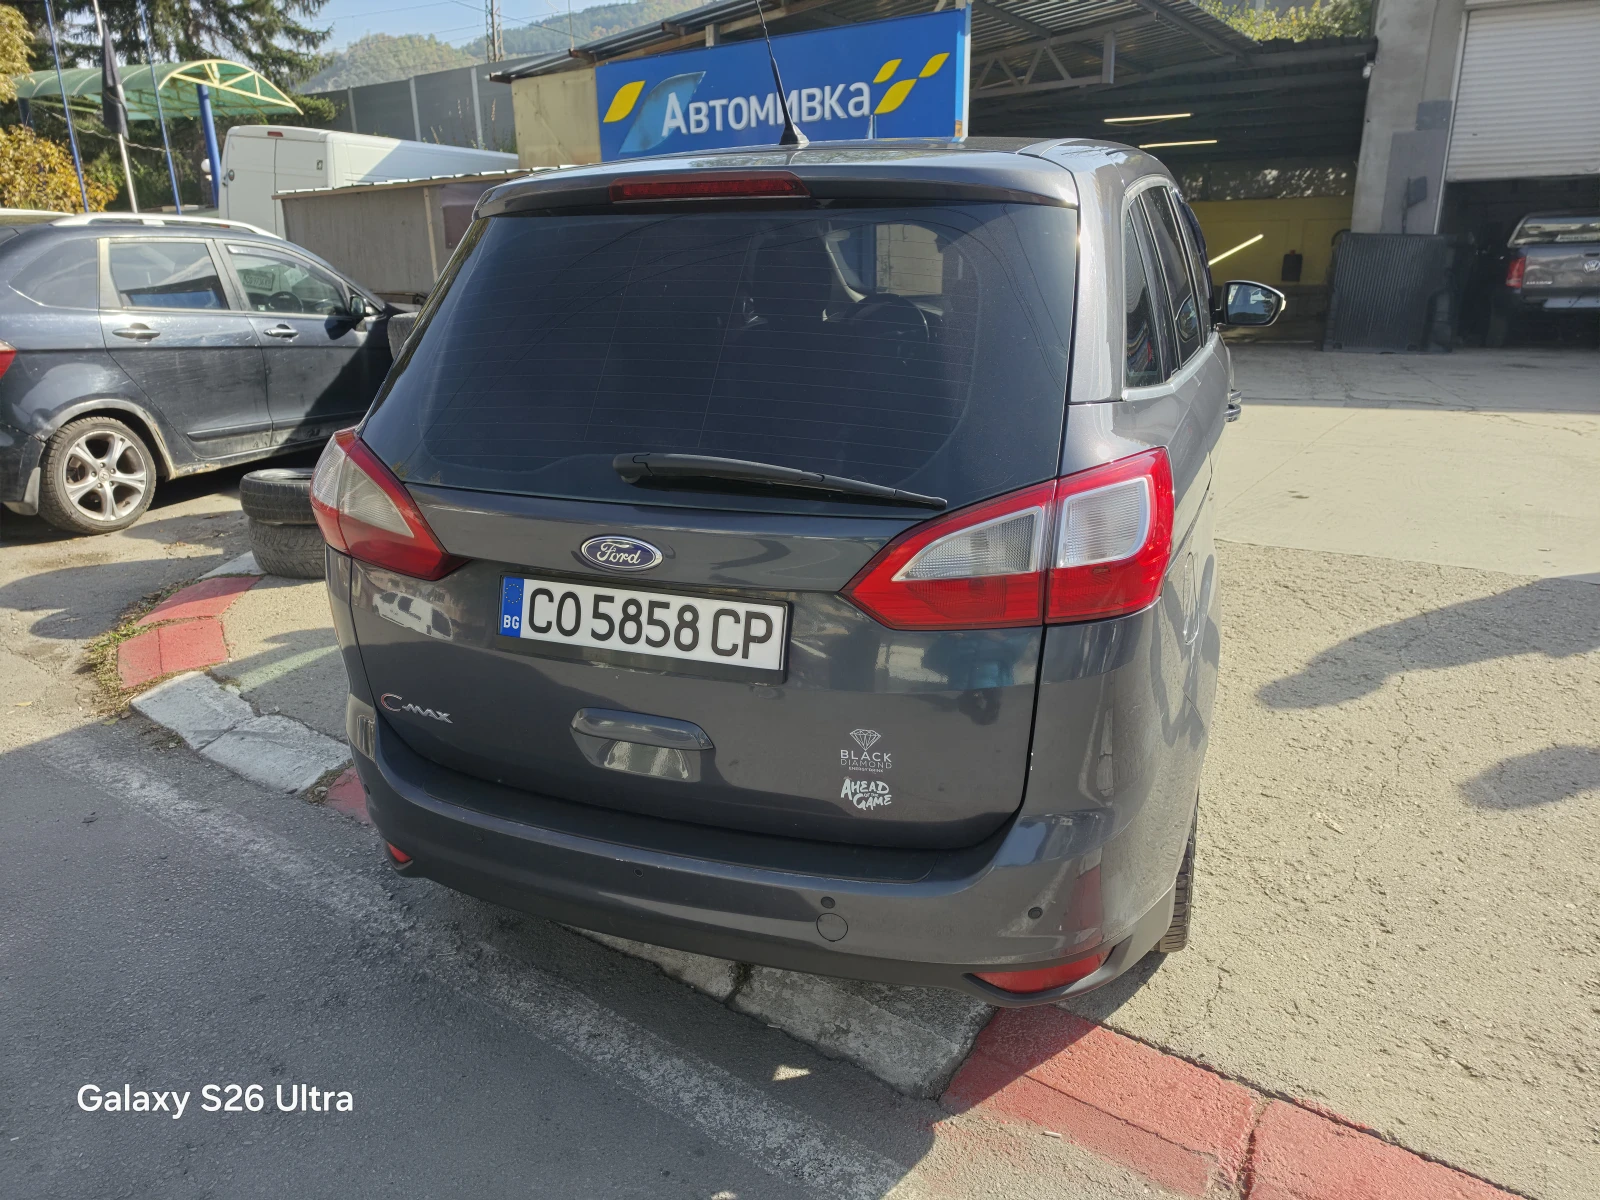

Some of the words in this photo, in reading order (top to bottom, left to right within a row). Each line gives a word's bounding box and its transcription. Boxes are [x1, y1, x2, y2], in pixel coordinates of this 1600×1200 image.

[596, 541, 642, 564] Ford
[503, 614, 520, 629] BG
[528, 587, 582, 637] CO
[590, 593, 700, 652] 5858
[711, 608, 774, 660] CP
[380, 693, 454, 724] C-MAX
[840, 749, 892, 763] BLACK
[840, 759, 892, 769] DIAMOND
[840, 778, 889, 801] AHEAD
[853, 793, 892, 811] GAME
